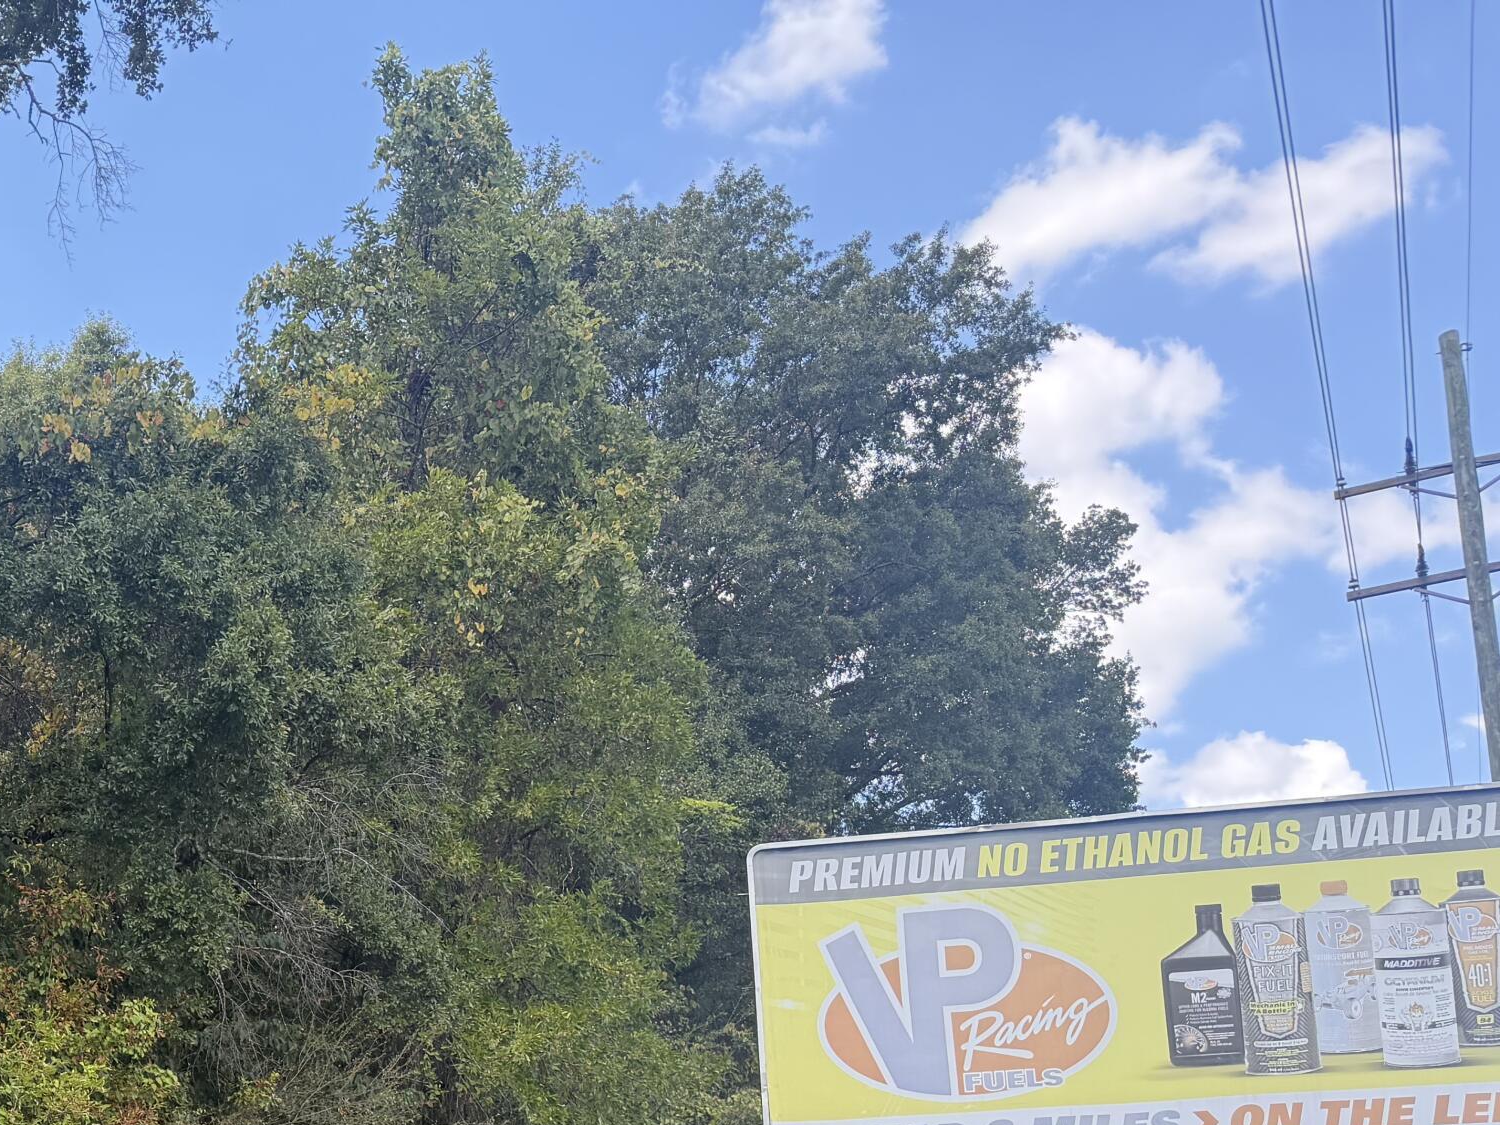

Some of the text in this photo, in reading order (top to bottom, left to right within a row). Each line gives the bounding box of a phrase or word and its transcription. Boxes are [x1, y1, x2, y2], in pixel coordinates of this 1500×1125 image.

[788, 847, 966, 893] PREMIUM
[977, 843, 1028, 878] NO
[1039, 827, 1209, 874] ETHANOL
[1221, 820, 1300, 859] GAS
[1253, 965, 1293, 978] FIX-IT
[1383, 957, 1441, 968] MADDITIVE
[1258, 979, 1293, 992] FUEL
[1468, 963, 1493, 988] 40:1
[820, 904, 1019, 1097] VP
[1191, 992, 1207, 1004] M2
[960, 994, 1108, 1071] Racing
[962, 1068, 1065, 1093] FUELS
